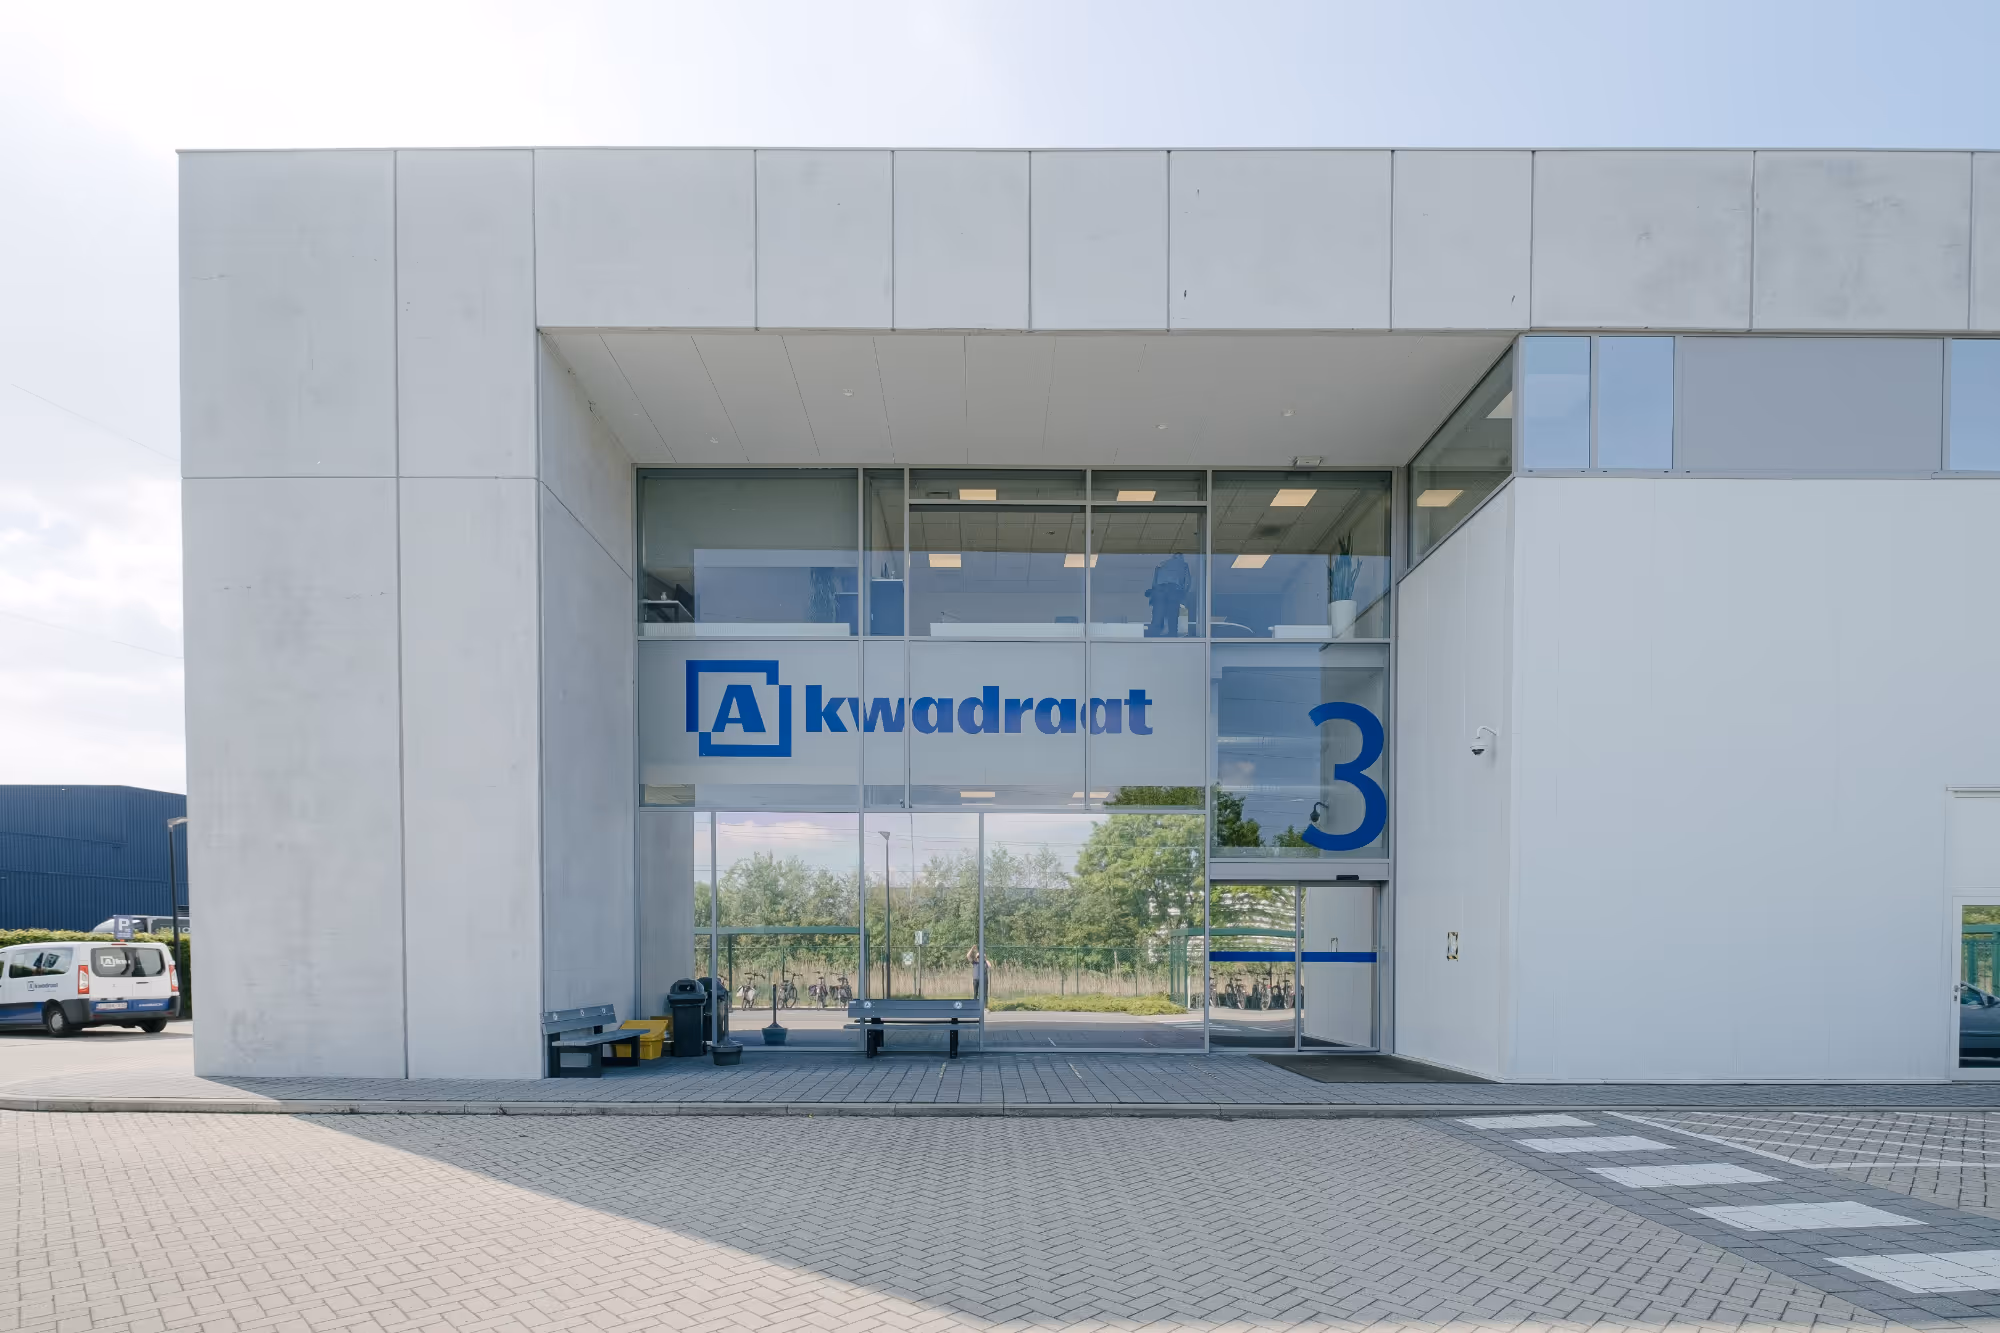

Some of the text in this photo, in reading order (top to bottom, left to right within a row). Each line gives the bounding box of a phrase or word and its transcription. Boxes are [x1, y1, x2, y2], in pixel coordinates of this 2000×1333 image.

[805, 685, 1154, 735] kwadraat
[1301, 701, 1387, 851] 3
[118, 918, 130, 931] P
